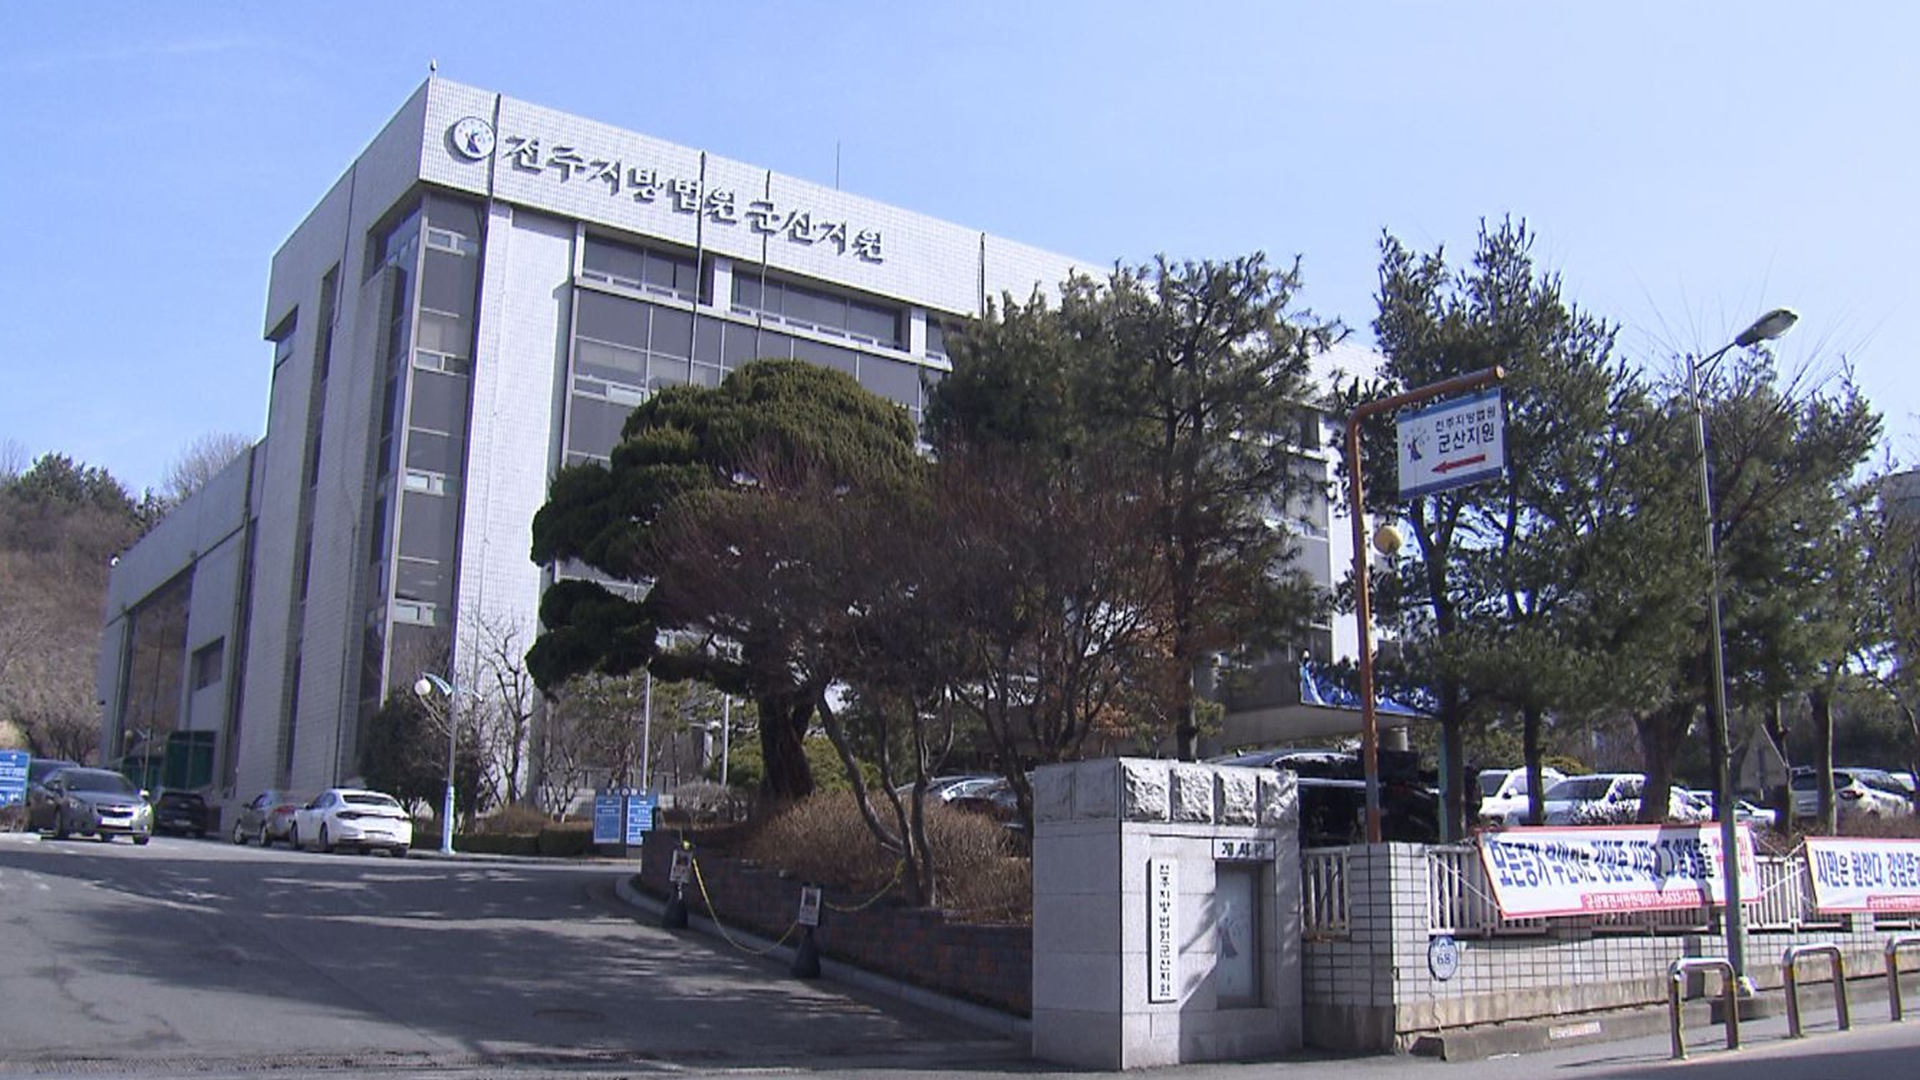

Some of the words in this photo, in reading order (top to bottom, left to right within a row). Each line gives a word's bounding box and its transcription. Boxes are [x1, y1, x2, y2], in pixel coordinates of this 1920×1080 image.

[503, 136, 738, 225] 전주지방법원
[744, 197, 883, 263] 군산지원
[1436, 405, 1496, 433] 전주지방법원
[1438, 422, 1495, 454] 군산지원
[1814, 850, 1850, 888] 시민은
[1436, 953, 1451, 965] 68
